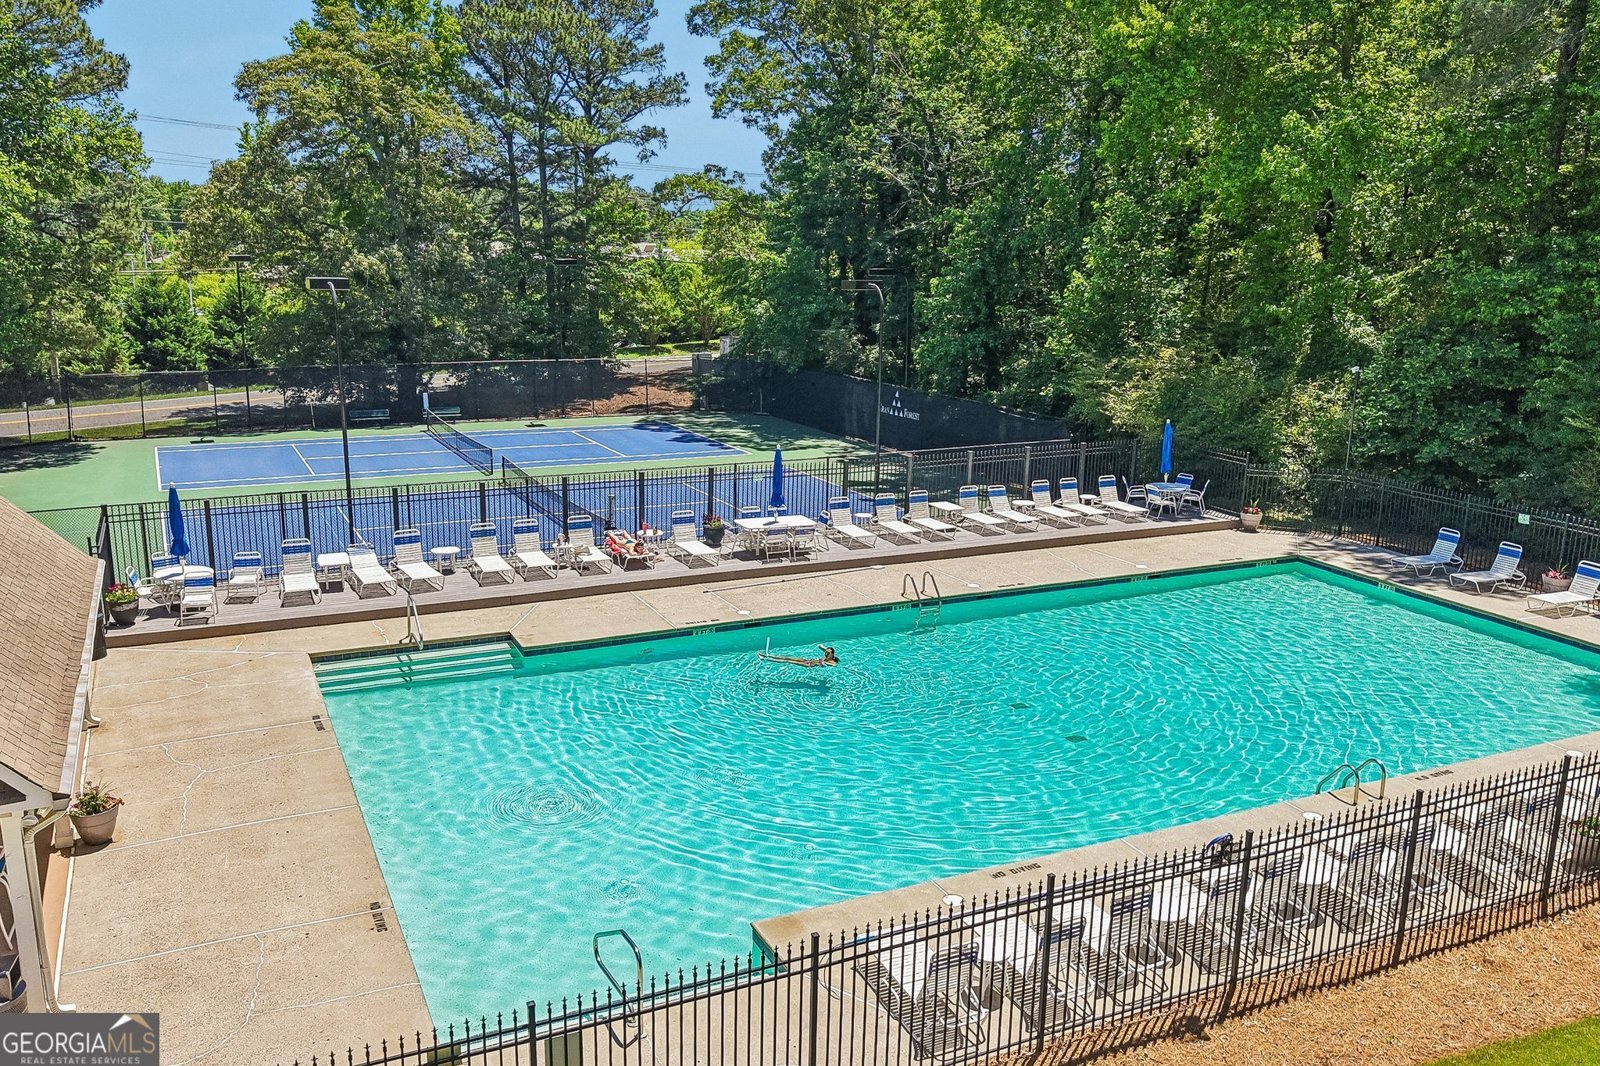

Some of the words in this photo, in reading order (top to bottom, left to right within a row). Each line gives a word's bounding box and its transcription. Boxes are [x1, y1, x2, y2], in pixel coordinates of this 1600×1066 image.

[992, 871, 1006, 879] NO
[1009, 862, 1042, 874] DIVING
[370, 901, 381, 911] NO
[372, 912, 388, 933] DIVING
